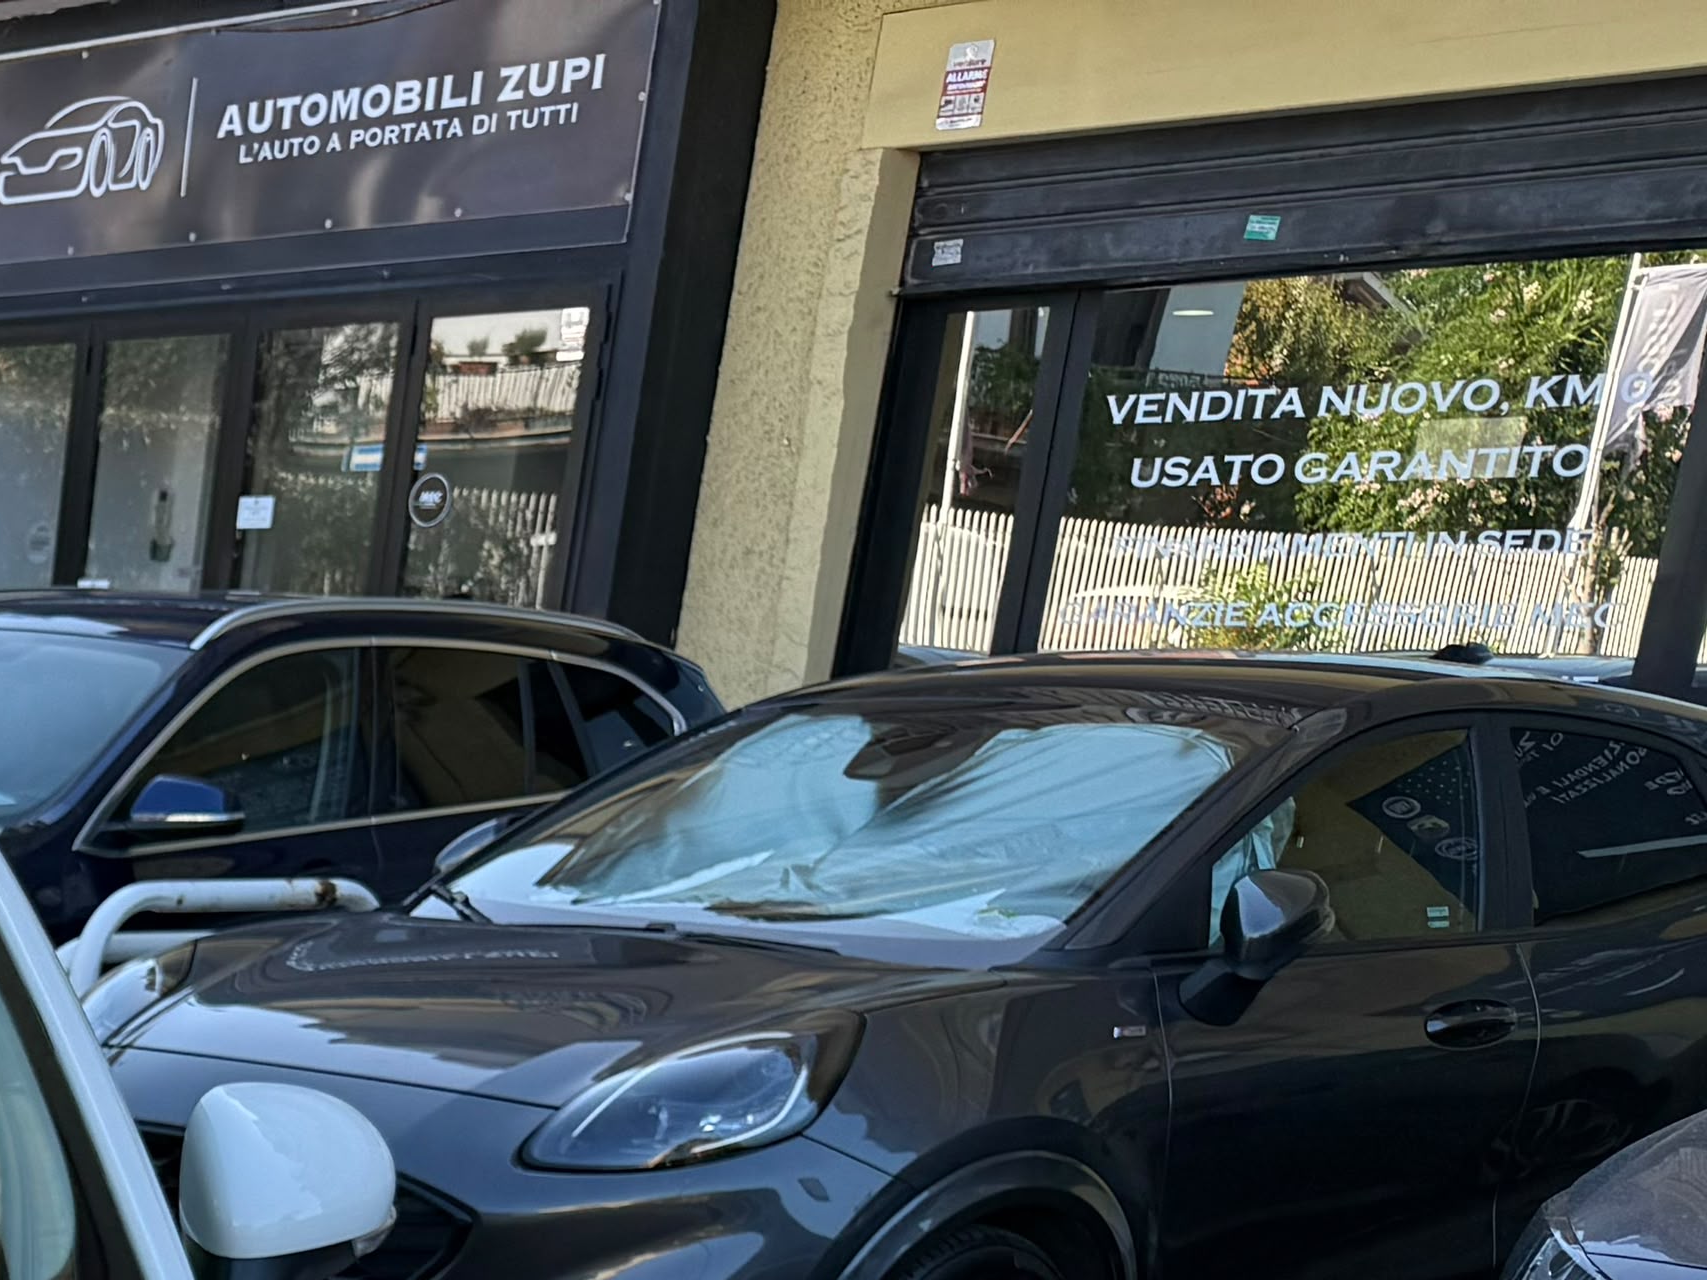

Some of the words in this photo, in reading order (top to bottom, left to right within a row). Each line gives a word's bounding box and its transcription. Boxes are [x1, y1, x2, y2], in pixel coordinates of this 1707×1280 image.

[216, 70, 484, 139] AUTOMOBILI
[497, 53, 607, 102] ZUPI
[238, 133, 322, 164] L'AUTO
[325, 136, 342, 153] A
[349, 117, 464, 150] PORTATA
[471, 115, 498, 137] DI
[506, 102, 580, 131] TUTTI
[1106, 386, 1306, 425] VENDITA
[1316, 379, 1511, 418] NUOVO,
[1523, 374, 1605, 409] KM
[1130, 452, 1286, 488] USATO
[1293, 444, 1590, 483] GARANTITO
[1424, 530, 1468, 560] IN
[1476, 528, 1593, 556] SEDE
[1255, 601, 1516, 629] ACCESSORIE
